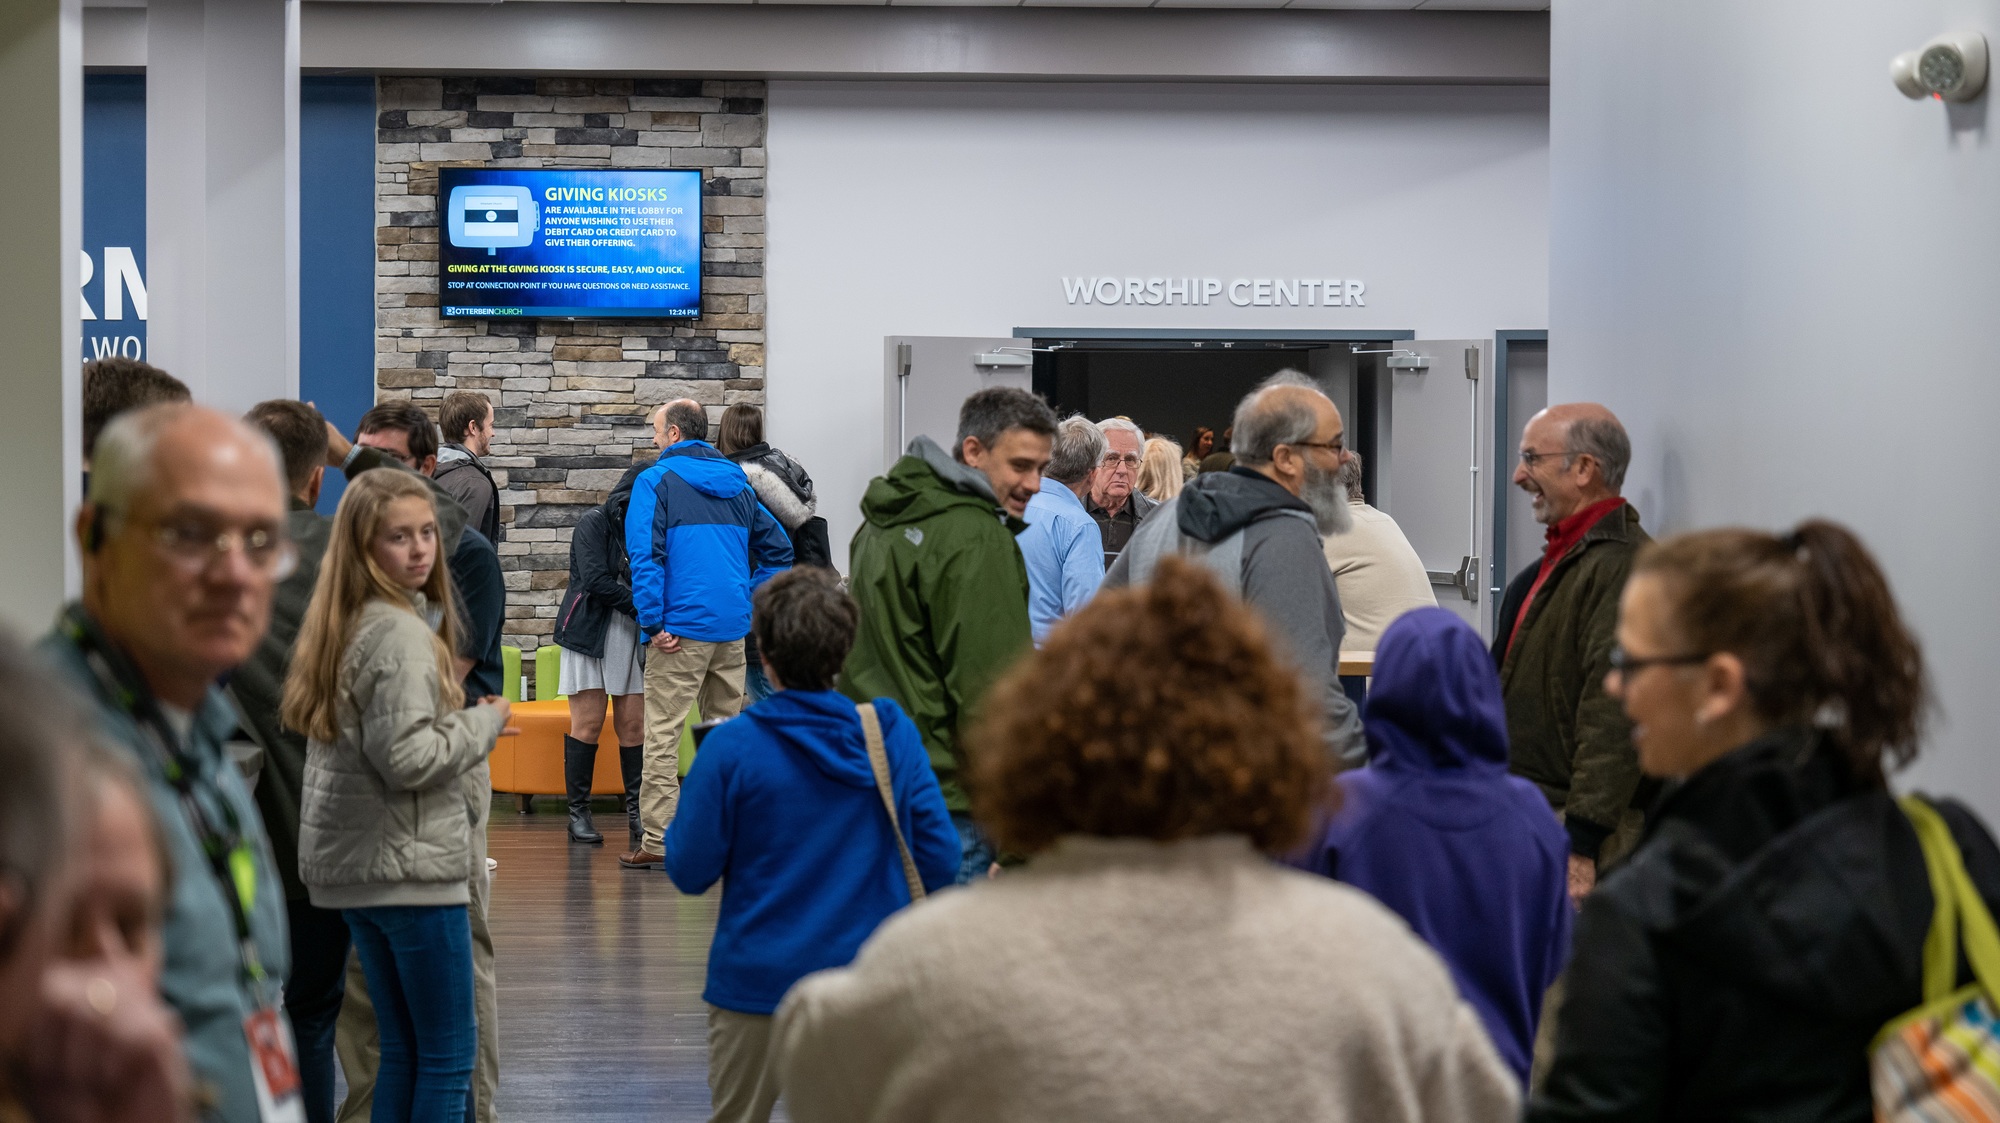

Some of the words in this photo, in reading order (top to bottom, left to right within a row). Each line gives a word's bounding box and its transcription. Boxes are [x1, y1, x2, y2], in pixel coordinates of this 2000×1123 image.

[545, 187, 603, 201] GIVING
[608, 187, 667, 201] KIOSKS
[545, 206, 561, 214] ARE
[563, 206, 608, 214] AVAILABLE
[610, 206, 618, 214] IN
[620, 206, 636, 214] THE
[637, 206, 664, 214] LOBBY
[666, 206, 683, 214] FOR
[545, 217, 580, 225] ANYONE
[581, 217, 618, 225] WISHING
[619, 217, 631, 225] TO
[632, 217, 648, 225] USE
[650, 217, 674, 225] THEIR
[545, 228, 569, 236] DEBIT
[570, 228, 594, 236] CARD
[596, 228, 607, 236] OR
[609, 228, 639, 236] CREDIT
[640, 228, 664, 236] CARD
[665, 228, 677, 236] TO
[545, 239, 565, 247] GIVE
[566, 239, 590, 247] THEIR
[591, 239, 636, 247] OFFERING.
[447, 265, 478, 273] GIVING
[479, 265, 490, 273] AT
[491, 265, 508, 273] THE
[508, 265, 539, 273] GIVING
[540, 265, 566, 273] KIOSK
[567, 265, 574, 273] IS
[576, 266, 610, 274] SECURE,
[611, 266, 635, 274] EASY,
[563, 282, 581, 290] HAVE
[582, 282, 620, 290] QUESTIONS
[620, 282, 630, 290] OR
[631, 282, 649, 290] NEED
[650, 282, 690, 290] ASSISTANCE.
[1062, 277, 1223, 305] WORSHIP
[1227, 279, 1366, 307] CENTER
